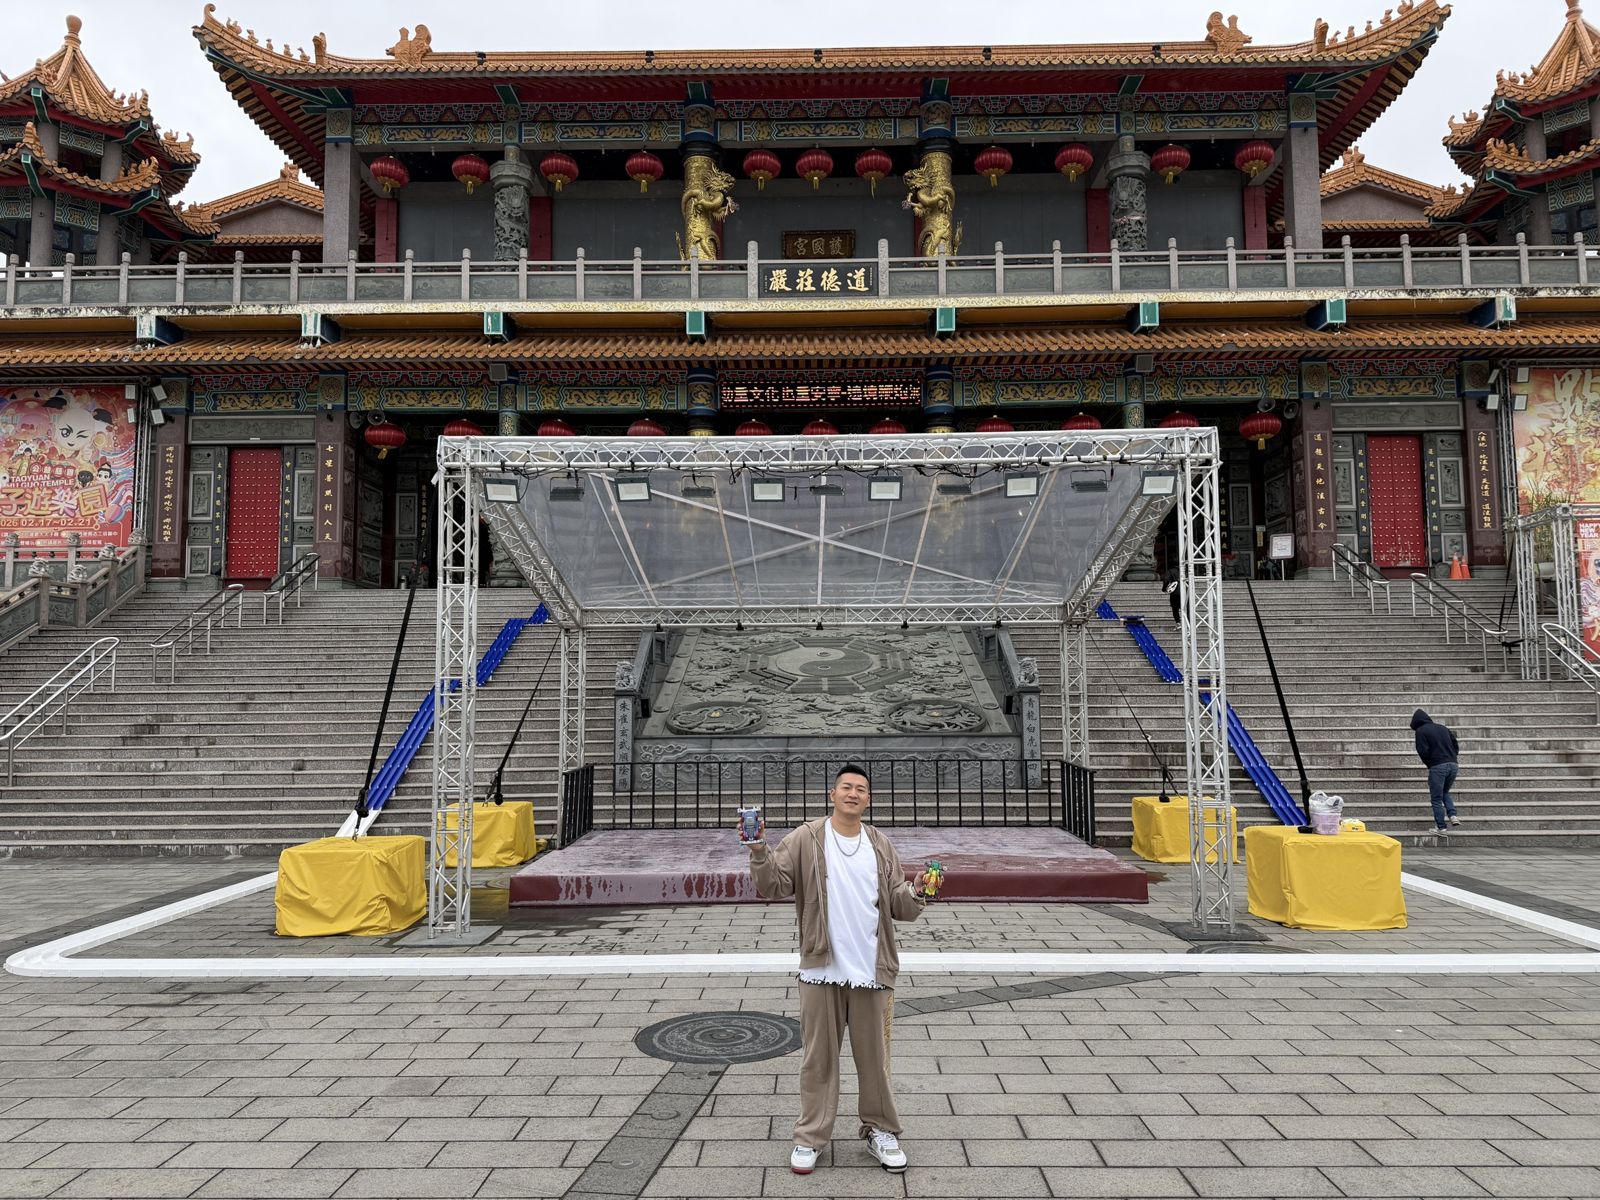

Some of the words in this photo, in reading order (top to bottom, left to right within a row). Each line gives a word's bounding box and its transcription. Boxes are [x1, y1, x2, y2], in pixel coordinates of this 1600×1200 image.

[794, 236, 845, 256] 護國宮
[11, 474, 50, 483] TAOYUAN
[42, 479, 75, 487] TEMPLE
[21, 518, 92, 527] 02.17~02.21
